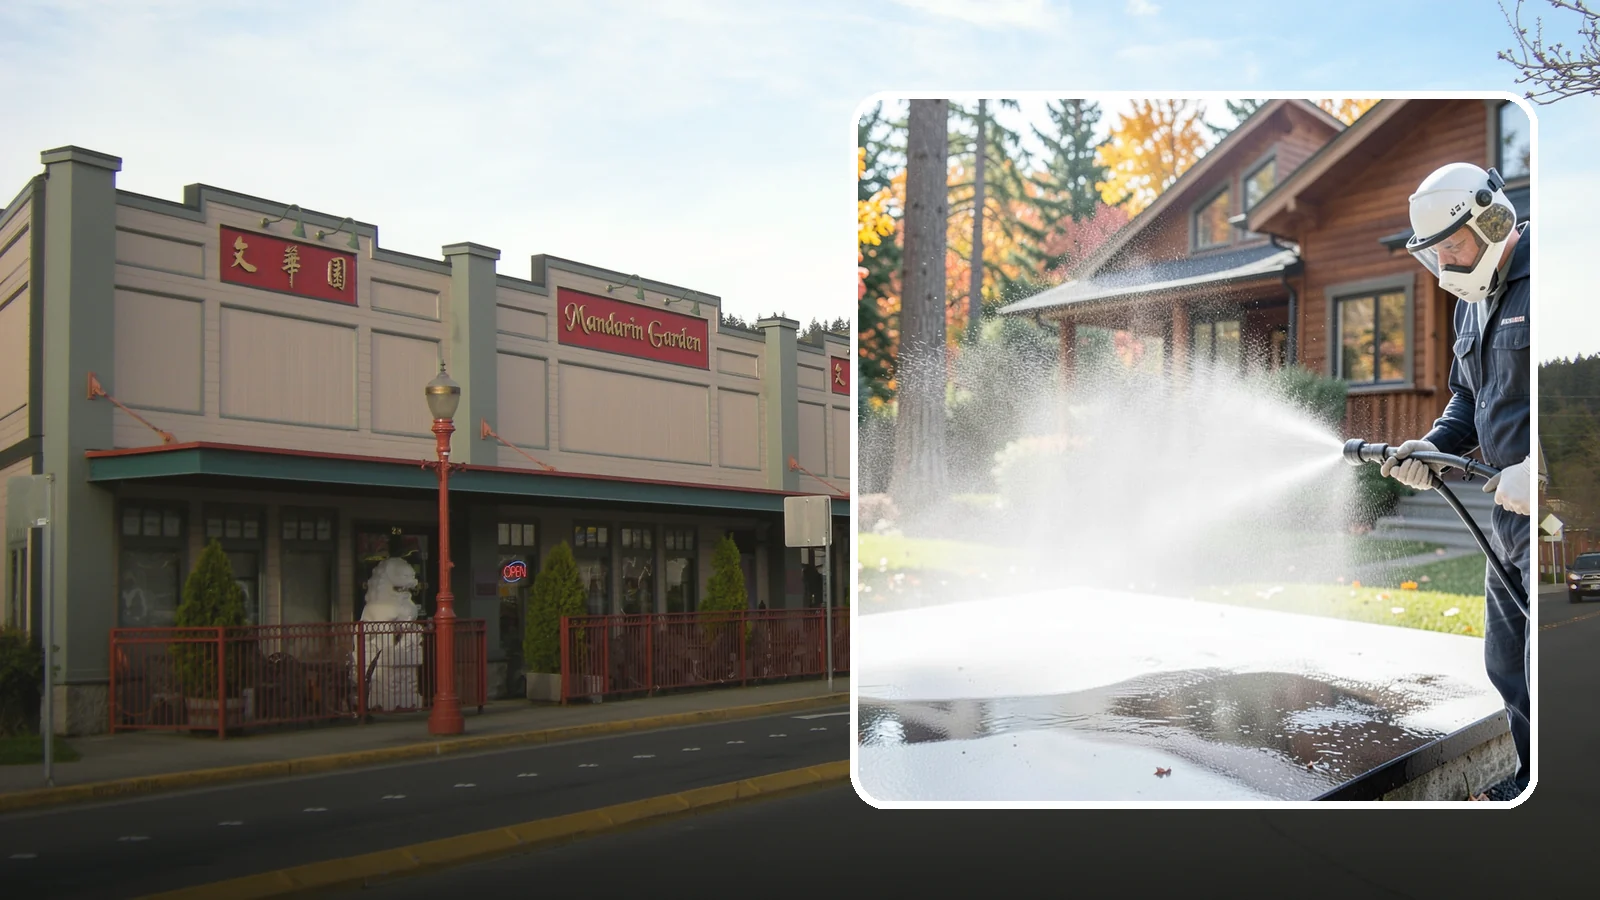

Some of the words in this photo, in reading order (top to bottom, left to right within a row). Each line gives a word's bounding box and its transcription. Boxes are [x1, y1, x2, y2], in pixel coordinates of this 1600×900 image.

[564, 302, 644, 341] Mandarin
[648, 320, 702, 352] Garden
[503, 565, 527, 578] OPEN
